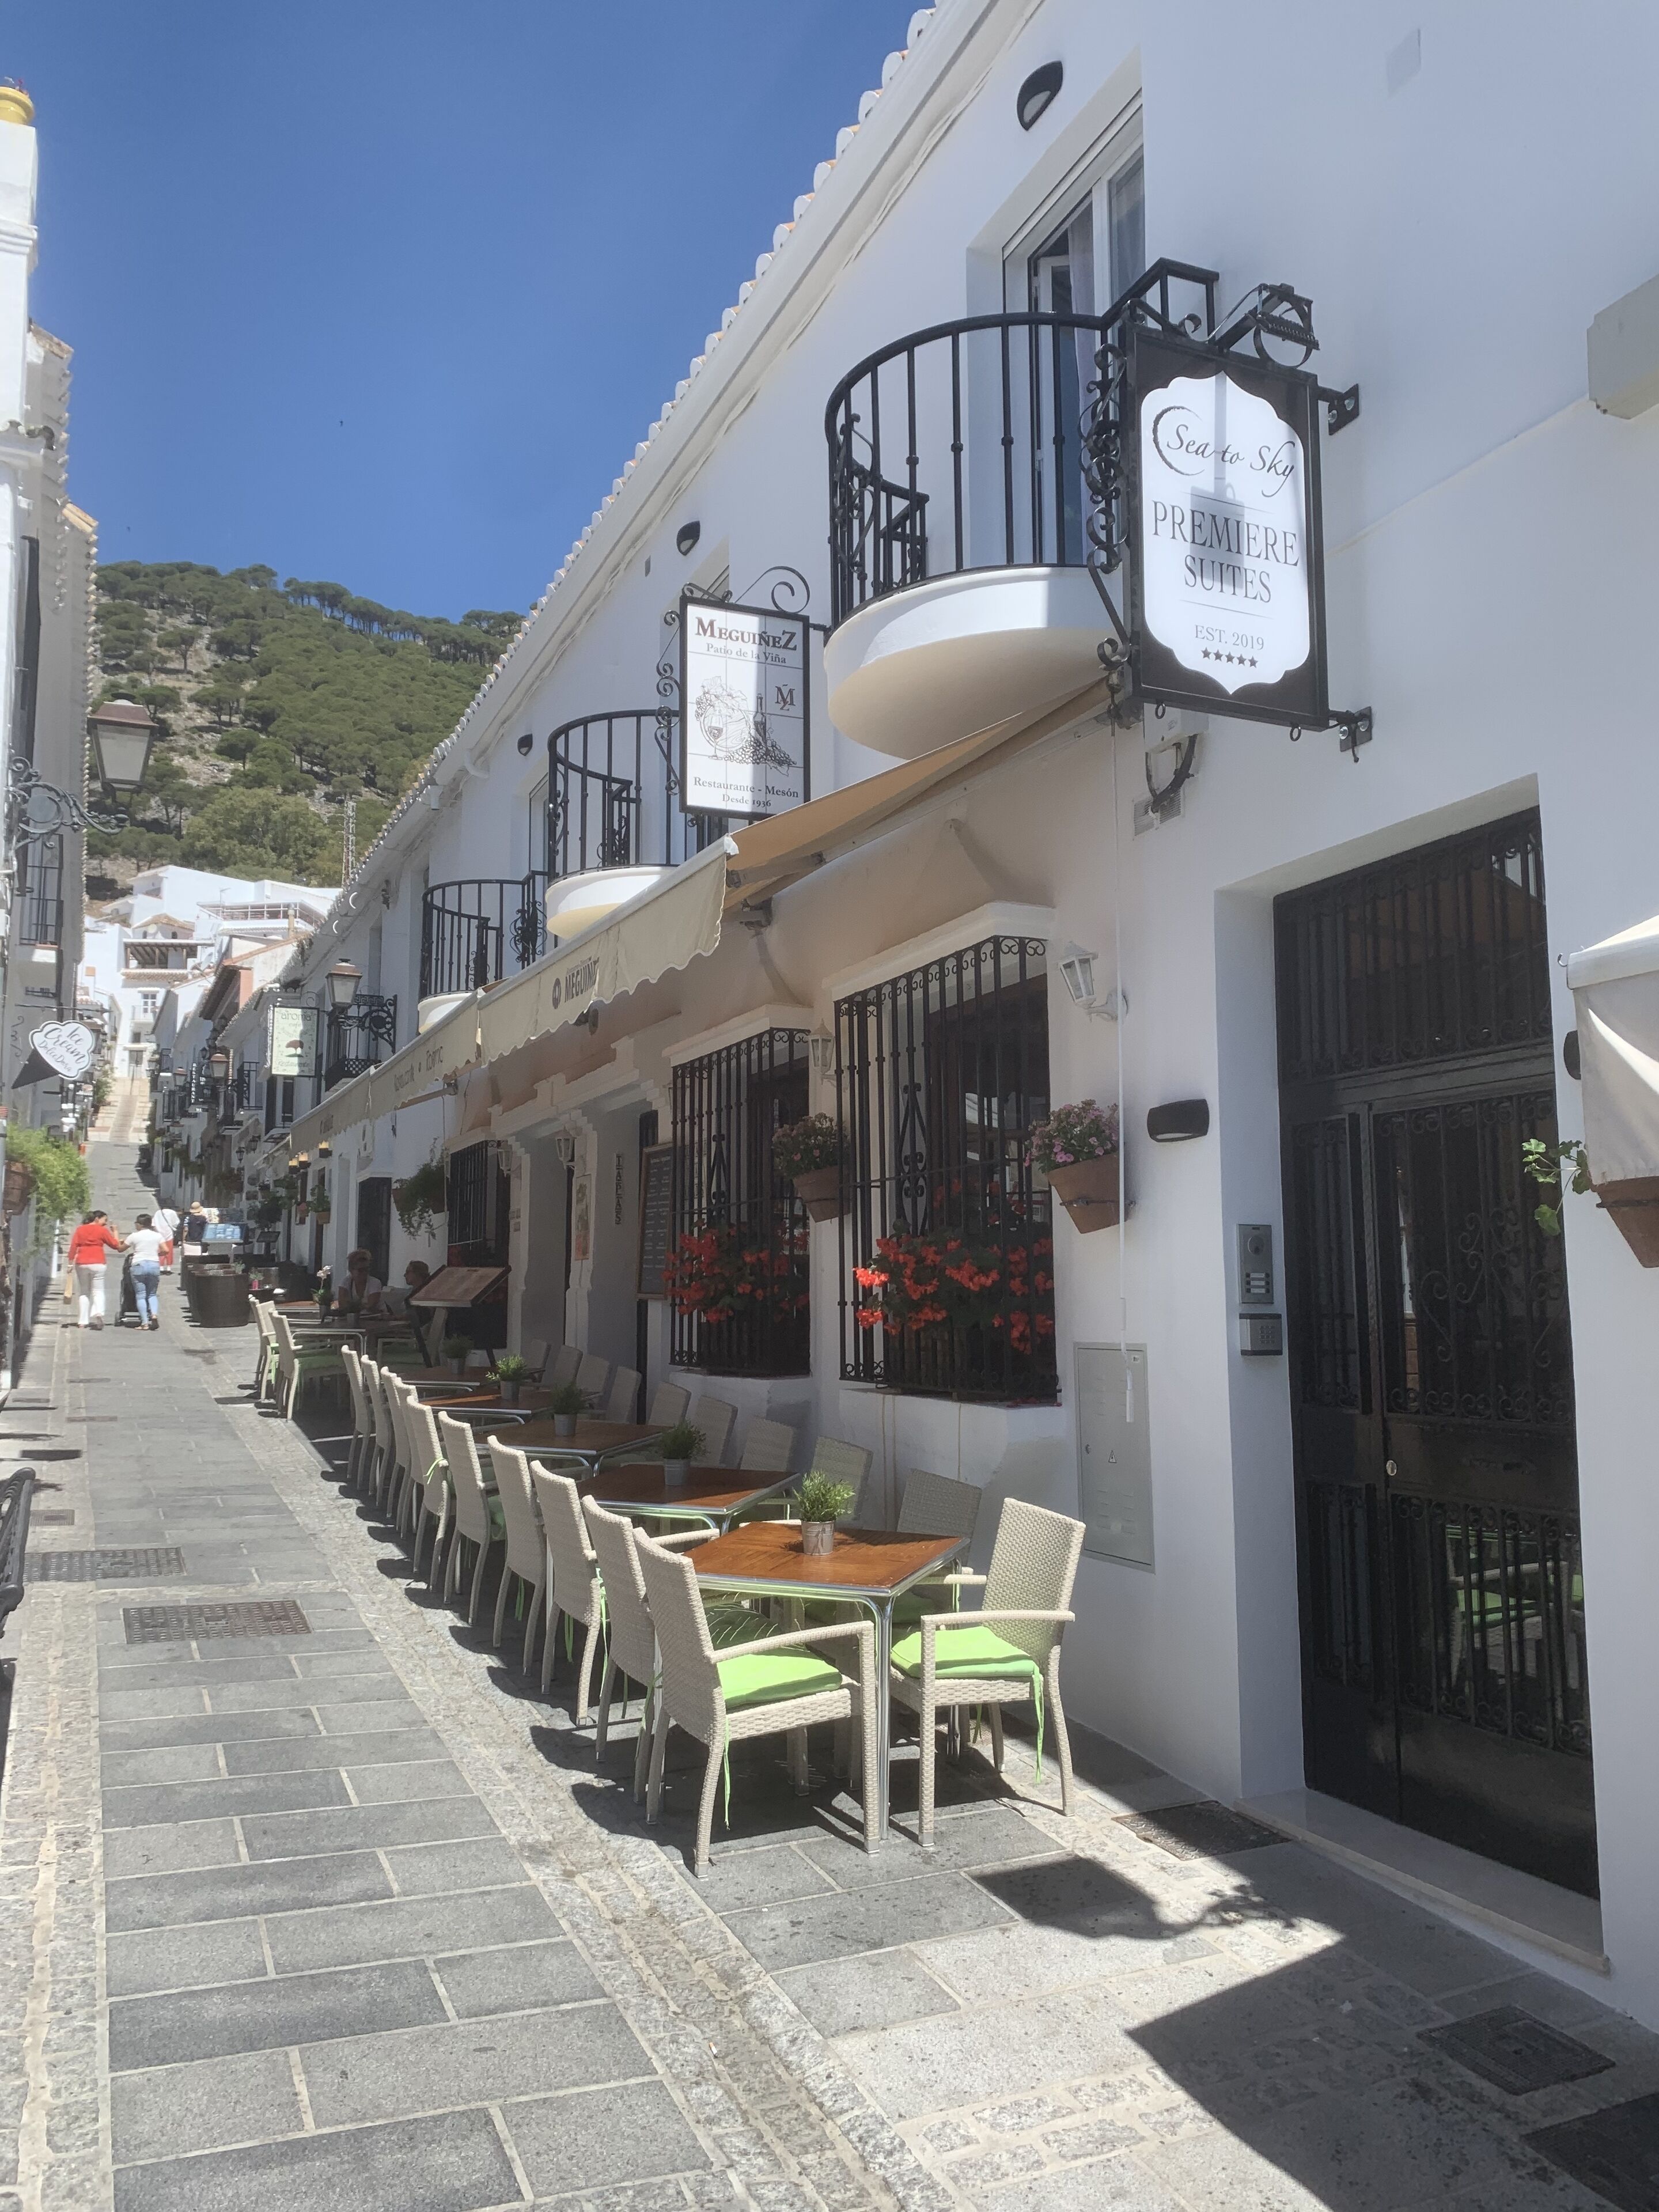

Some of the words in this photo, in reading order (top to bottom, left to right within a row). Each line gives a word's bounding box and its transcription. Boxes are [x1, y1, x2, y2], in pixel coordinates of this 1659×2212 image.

[1167, 423, 1216, 459] Sea
[1220, 446, 1244, 465] to
[1250, 440, 1296, 498] Sky
[1152, 500, 1300, 567] PREMIERE
[1184, 554, 1271, 604] SUITES
[1195, 624, 1228, 645] EST.
[1232, 631, 1264, 651] 2019
[706, 642, 733, 656] Patio
[736, 647, 749, 658] de
[751, 649, 760, 660] la
[763, 652, 787, 664] Viña
[694, 776, 755, 794] Restaurante
[764, 785, 799, 798] Mesón
[722, 794, 749, 805] Desde
[752, 799, 771, 808] 1936
[281, 1012, 311, 1021] aroma
[44, 1027, 86, 1064] Cream
[67, 1026, 84, 1046] Ice
